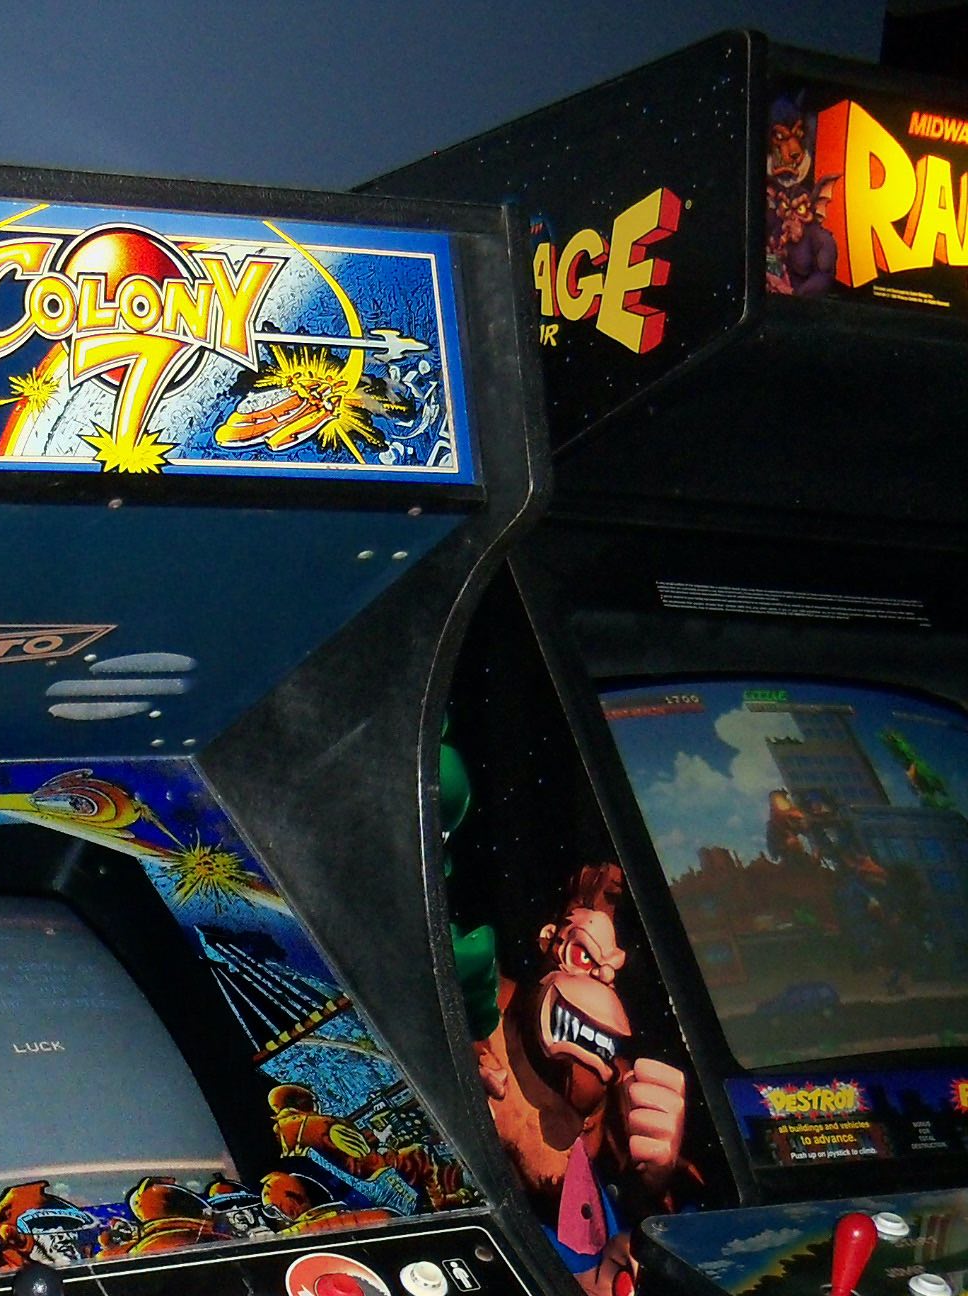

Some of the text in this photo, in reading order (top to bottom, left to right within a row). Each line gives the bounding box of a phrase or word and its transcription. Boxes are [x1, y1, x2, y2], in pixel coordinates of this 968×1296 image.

[815, 99, 968, 288] RA
[68, 330, 192, 452] 7
[12, 1040, 66, 1054] LUCK
[768, 1082, 856, 1113] DESTROY
[788, 1123, 824, 1134] buildings
[825, 1122, 839, 1131] and
[840, 1120, 870, 1130] vehicles
[801, 1133, 857, 1145] to advance.
[790, 1151, 807, 1160] Push
[827, 1149, 850, 1159] joystick
